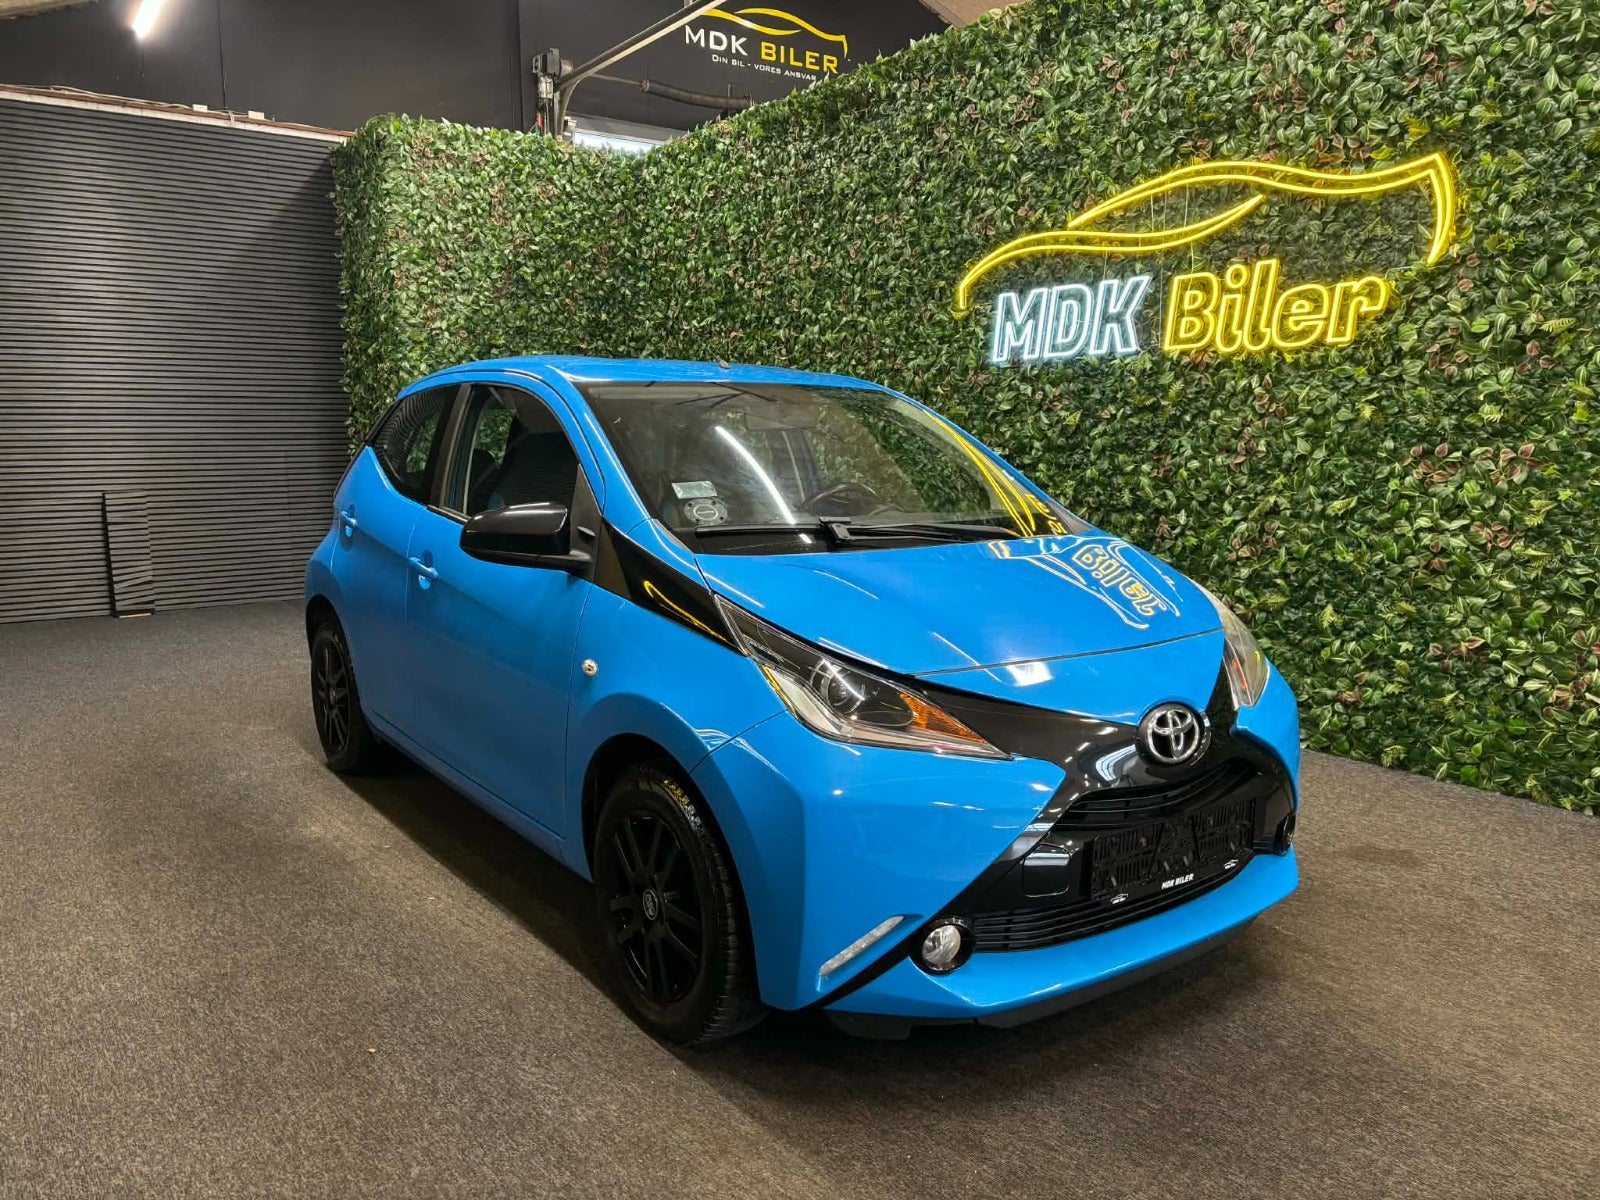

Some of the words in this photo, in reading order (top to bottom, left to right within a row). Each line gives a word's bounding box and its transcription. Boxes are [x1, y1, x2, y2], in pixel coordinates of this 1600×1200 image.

[685, 25, 748, 56] MDK
[761, 42, 838, 74] BILER
[731, 59, 745, 68] BIL
[754, 64, 782, 75] VORES
[784, 70, 817, 82] ANSVAR
[993, 275, 1152, 363] MDK
[1164, 257, 1391, 353] Biler
[1175, 873, 1194, 886] BILER
